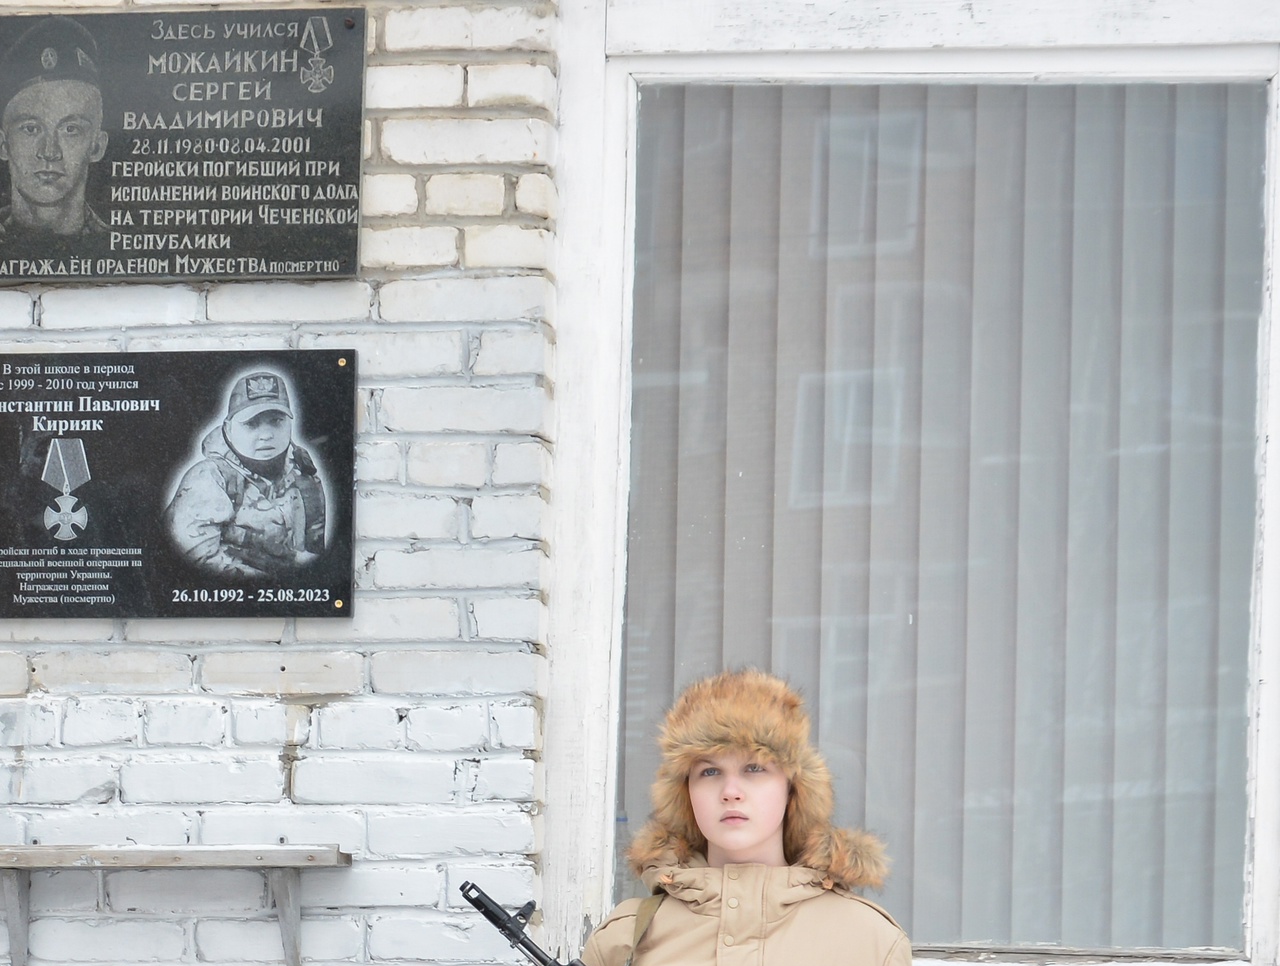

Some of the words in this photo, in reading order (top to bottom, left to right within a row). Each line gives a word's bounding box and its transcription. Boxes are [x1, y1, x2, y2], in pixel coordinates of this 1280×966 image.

[223, 22, 299, 39] УЧИЛСЯ
[147, 48, 299, 75] МОЖАЙКИН
[172, 78, 272, 101] СЕРГЕЙ
[122, 107, 324, 130] ВЛАДИМИРОВИЧ
[111, 159, 199, 177] ГЕРОЙСКИ
[202, 159, 301, 177] ПОГИБШИЙ
[305, 160, 340, 177] ПРИ
[110, 184, 217, 202] ИСПОЛНЕНИИ
[313, 183, 359, 200] ДОЛГА
[110, 210, 135, 226] НА
[139, 208, 253, 225] ТЕРРИТОРИИ
[96, 257, 169, 275] ОРДЕНОМ
[269, 260, 340, 273] ПОСМЕРТНО
[2, 363, 12, 375] В
[15, 364, 41, 375] этой
[44, 365, 80, 374] школе
[83, 365, 91, 374] в
[93, 364, 135, 376] период
[8, 379, 35, 390] 1999
[45, 379, 73, 390] 2010
[76, 380, 95, 390] год
[98, 380, 139, 392] учился
[78, 396, 160, 412] Павлович
[32, 416, 104, 435] Кирияк
[31, 546, 58, 557] погиб
[67, 548, 88, 556] ходе
[90, 547, 142, 557] проведения
[47, 559, 84, 567] военной
[86, 560, 129, 569] операции
[16, 572, 68, 580] территории
[70, 570, 112, 580] Украины.
[19, 582, 69, 593] Награжден
[71, 583, 109, 592] орденом
[171, 589, 244, 602] 26.10.1992
[257, 588, 330, 602] 25.08.2023
[13, 594, 58, 605] Мужества
[60, 594, 116, 604] (посмертно)
